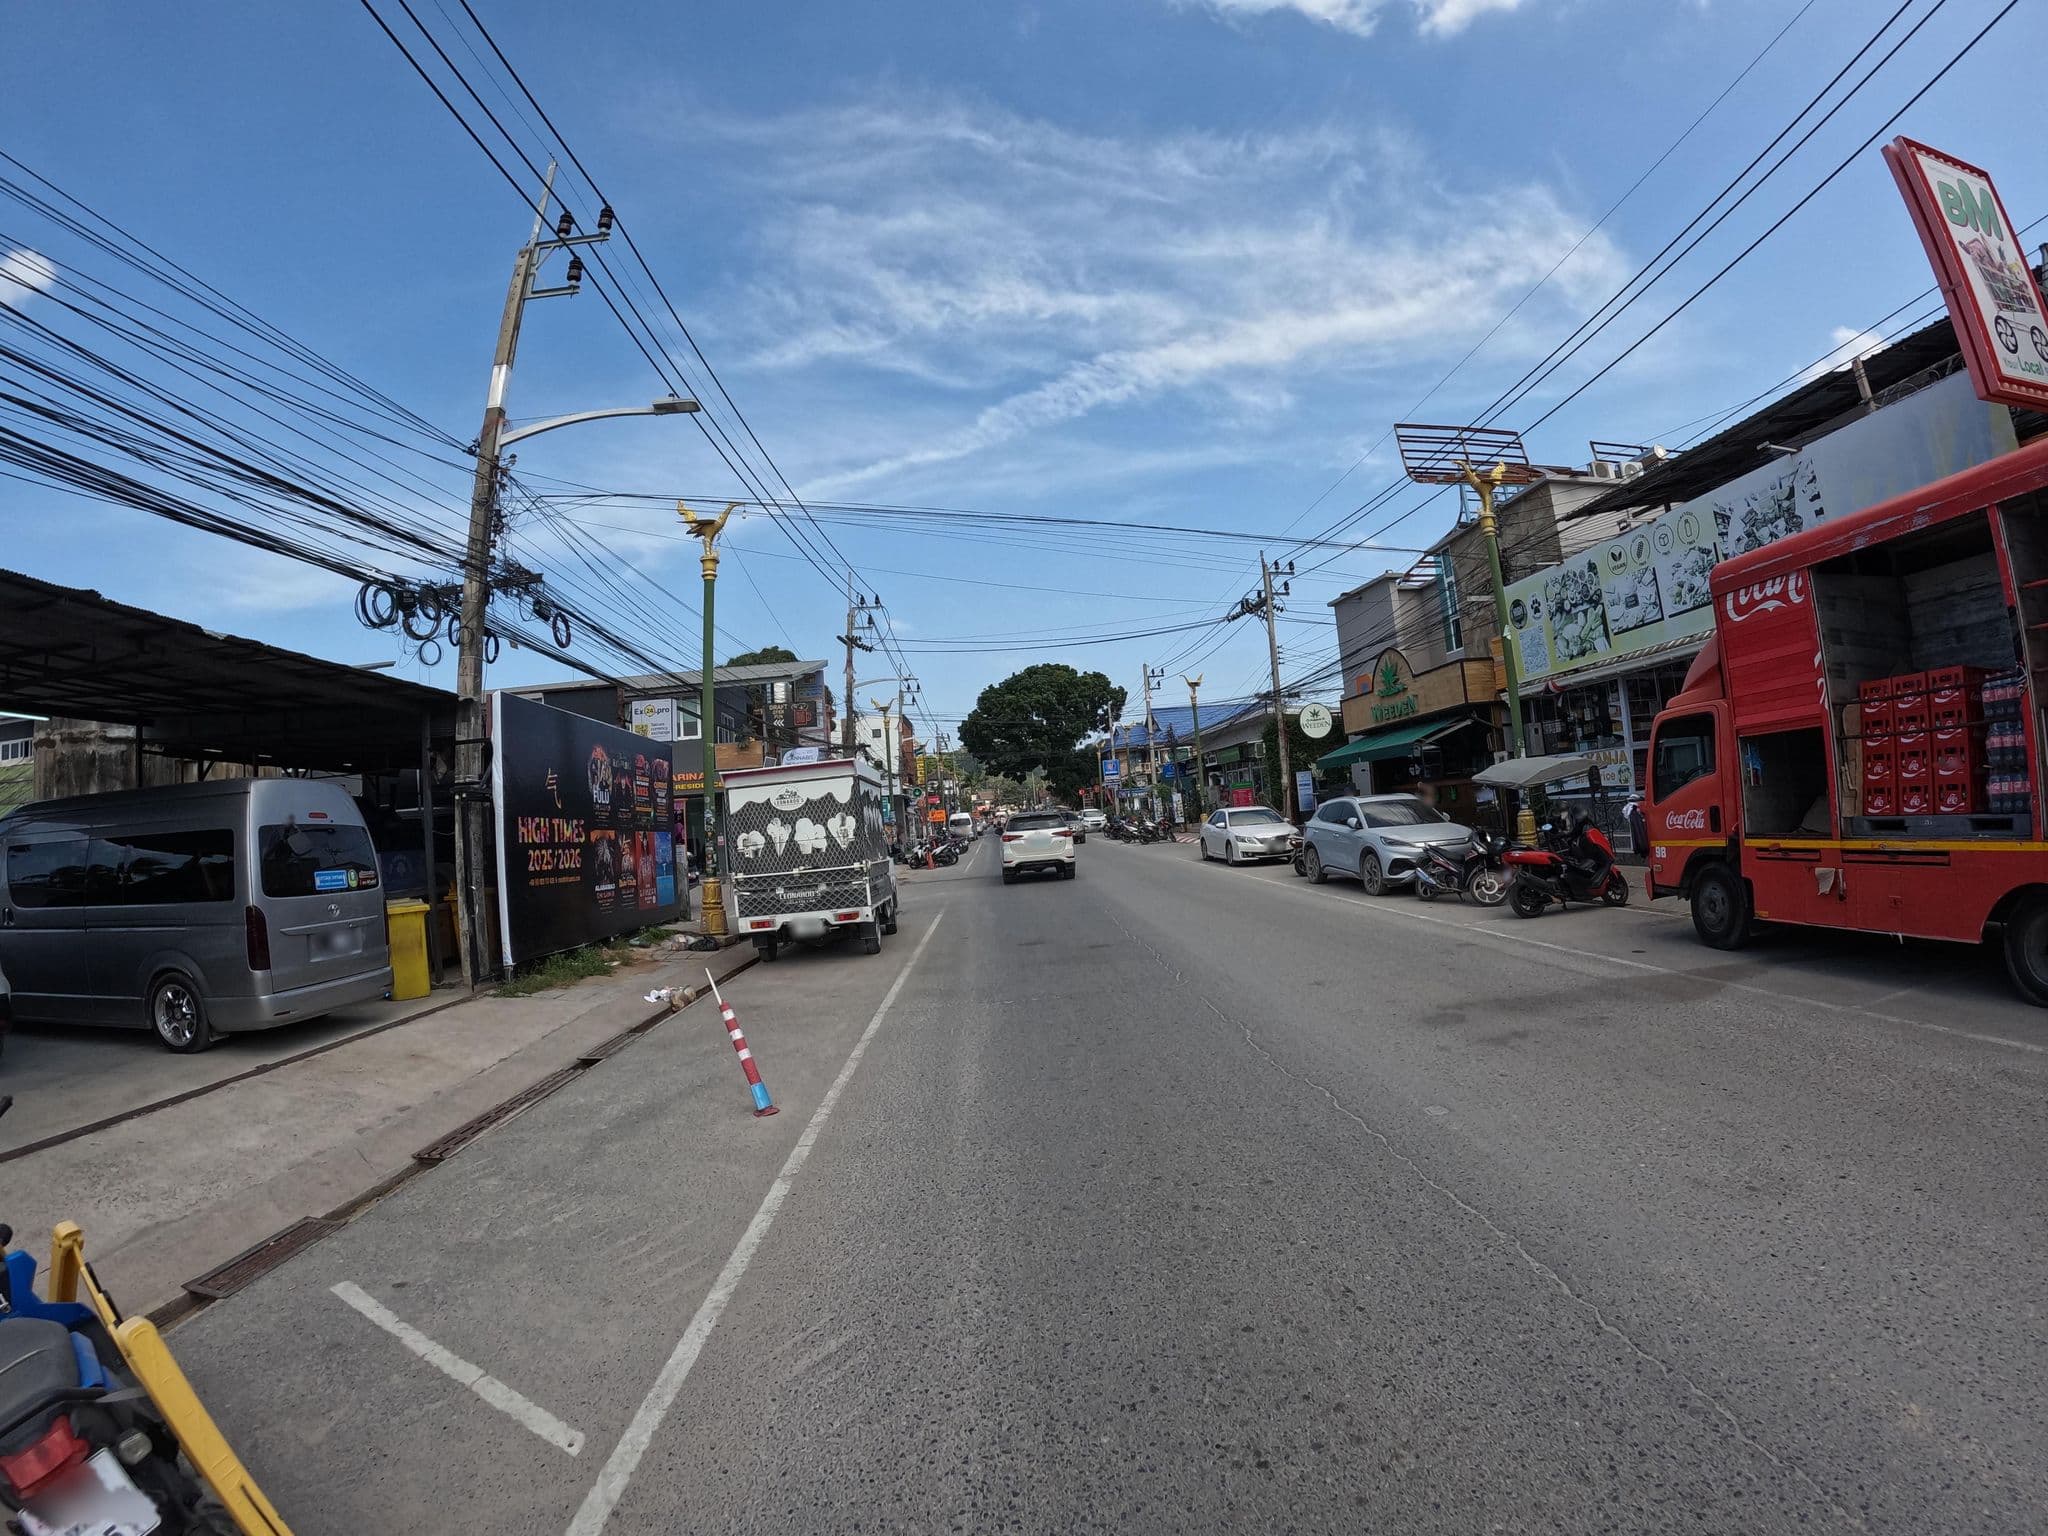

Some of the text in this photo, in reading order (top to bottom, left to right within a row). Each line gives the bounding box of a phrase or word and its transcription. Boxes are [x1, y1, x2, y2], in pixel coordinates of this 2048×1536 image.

[1937, 178, 2004, 242] BM
[1371, 694, 1418, 721] WEEDEN
[518, 816, 586, 843] HIGH TIMES
[1666, 808, 1706, 830] Coca-Cola
[528, 848, 582, 871] 2025/2026
